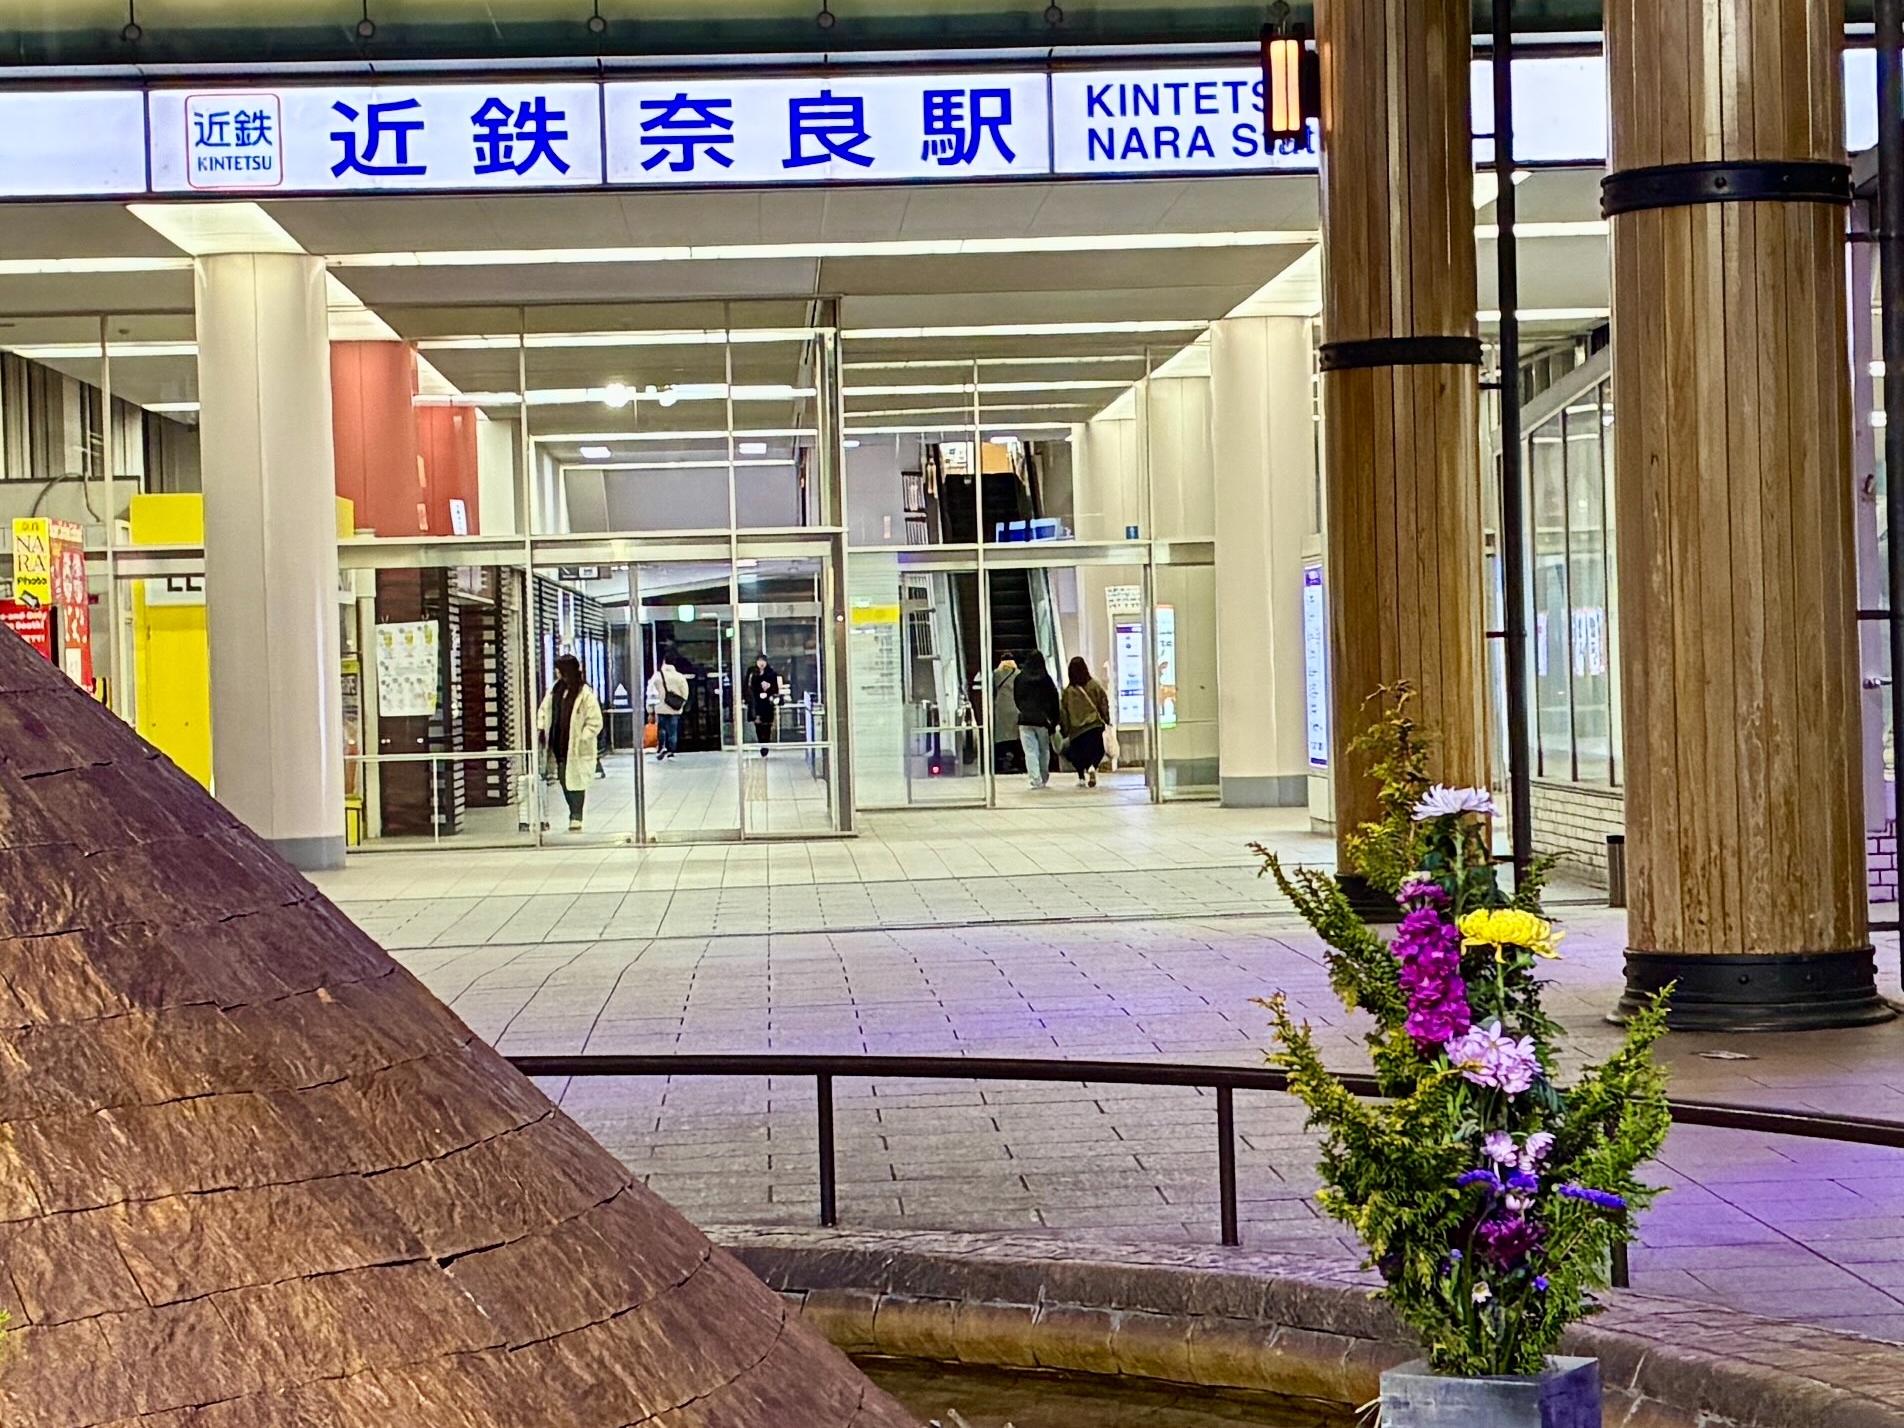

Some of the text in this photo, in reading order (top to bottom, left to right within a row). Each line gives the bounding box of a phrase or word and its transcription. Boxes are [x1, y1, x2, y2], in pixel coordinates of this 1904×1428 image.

[193, 109, 274, 147] 近鉄
[329, 88, 1017, 178] 近鉄奈良駅
[1088, 125, 1215, 161] NARA
[197, 155, 273, 172] KINTETSU
[17, 575, 48, 586] Photo
